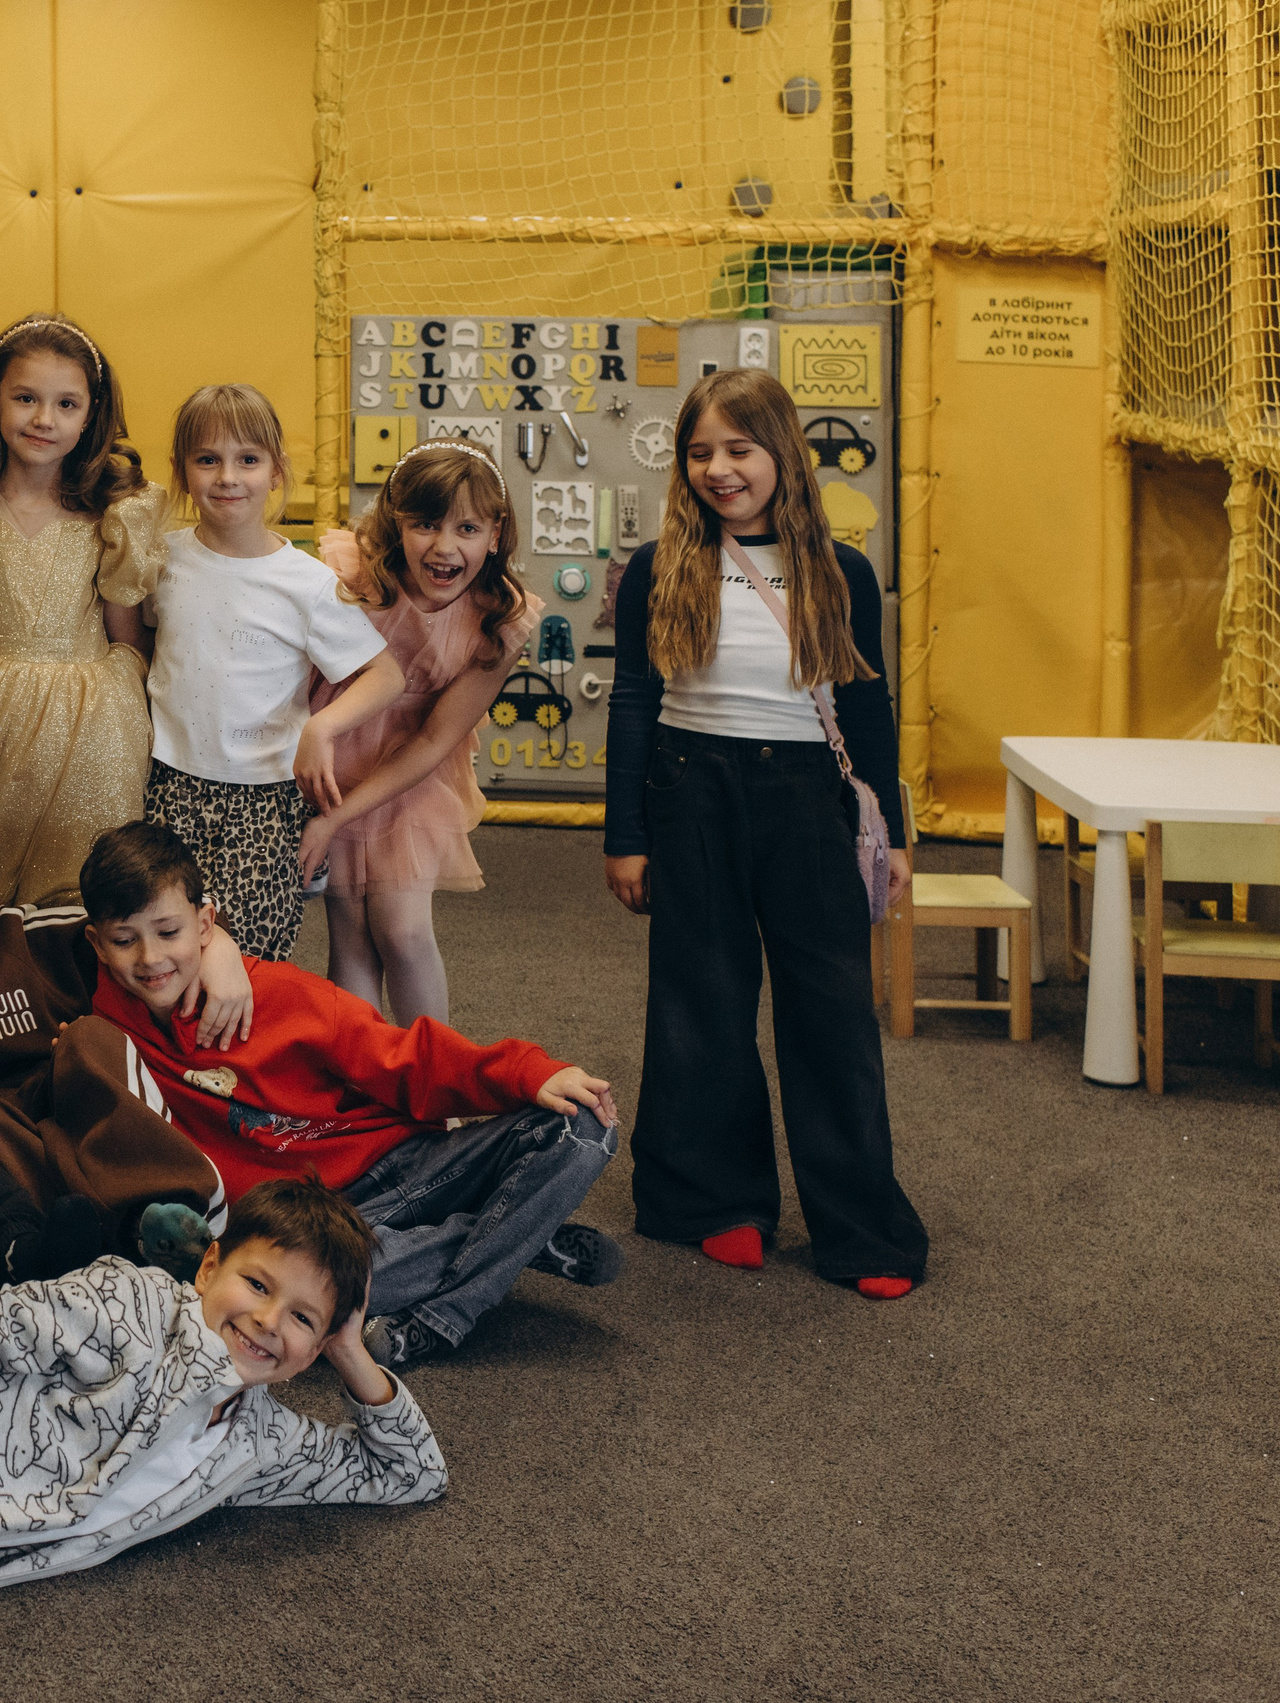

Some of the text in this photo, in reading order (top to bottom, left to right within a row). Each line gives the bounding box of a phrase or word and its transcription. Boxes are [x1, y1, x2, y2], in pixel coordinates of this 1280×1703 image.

[1002, 296, 1073, 312] лабіринт
[971, 312, 1089, 327] допускаються
[990, 327, 1070, 342] діти віком
[985, 344, 1073, 359] до 10 років
